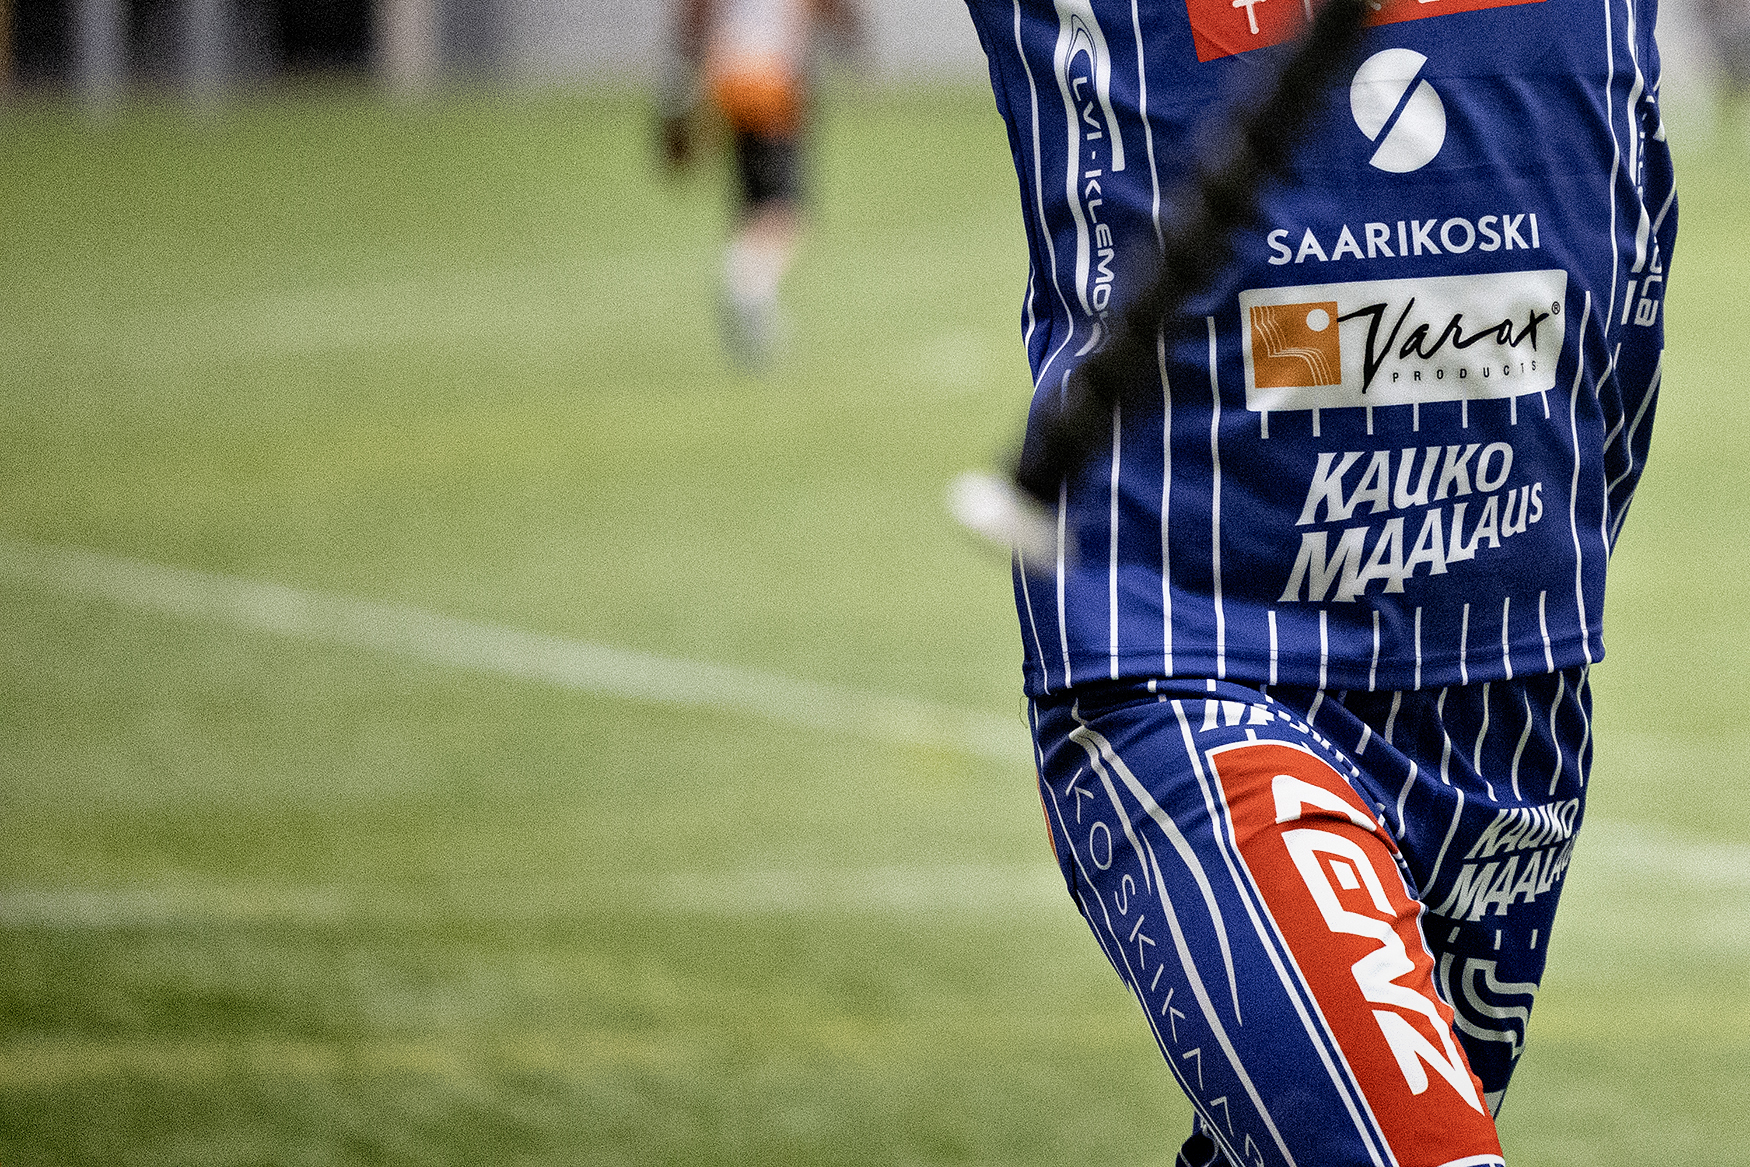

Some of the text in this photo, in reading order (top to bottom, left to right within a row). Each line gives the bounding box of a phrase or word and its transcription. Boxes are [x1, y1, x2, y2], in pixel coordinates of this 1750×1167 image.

[1266, 212, 1541, 266] SAARIKOSKI
[1392, 359, 1538, 383] PRODUCTS
[1294, 441, 1514, 526] KAUKO
[1277, 482, 1544, 603] MAALAUS
[1464, 797, 1580, 860] KAUKO
